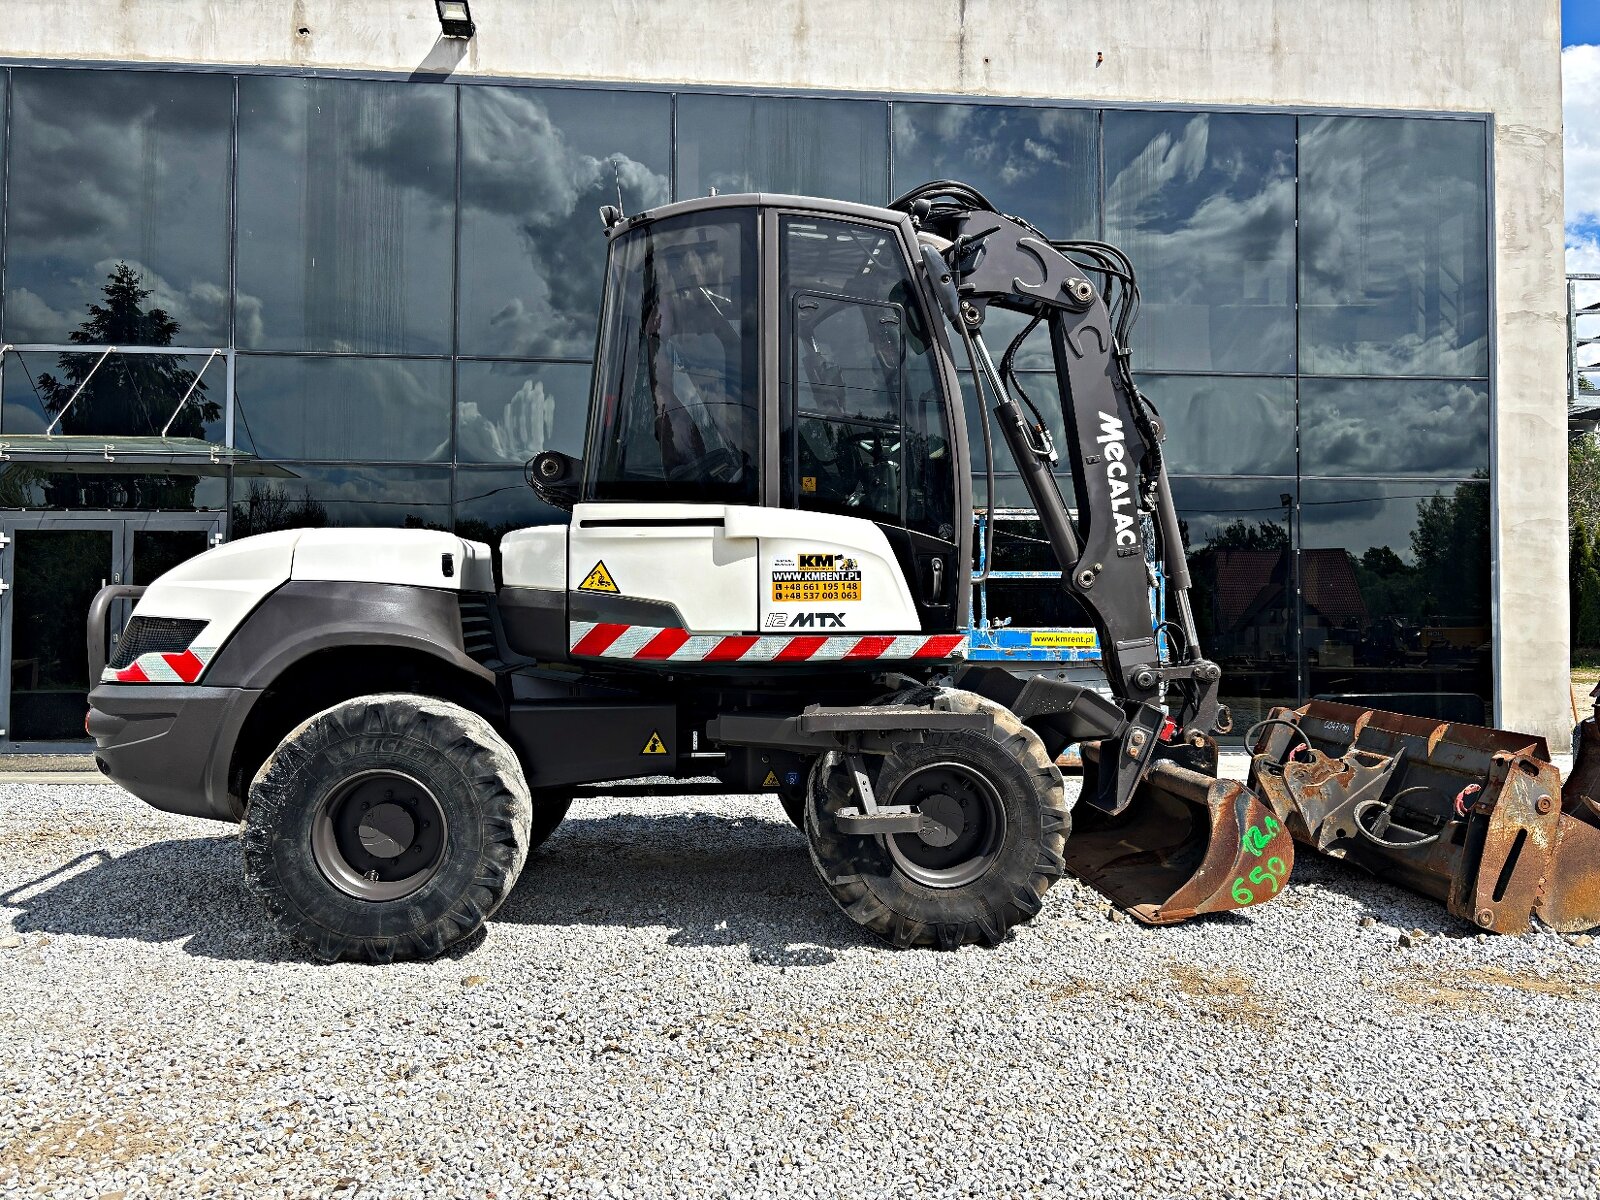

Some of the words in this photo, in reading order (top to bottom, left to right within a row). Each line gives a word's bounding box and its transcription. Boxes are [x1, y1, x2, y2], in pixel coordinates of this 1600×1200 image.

[799, 555, 834, 567] KM
[773, 571, 861, 581] WWW.KMRENT.PL
[784, 583, 801, 591] +48
[803, 583, 819, 591] 661
[823, 583, 839, 591] 195
[841, 583, 858, 591] 148
[784, 592, 801, 600] +48
[803, 592, 819, 600] 537
[822, 592, 839, 600] 003
[841, 592, 858, 600] 063
[765, 613, 788, 627] 12
[788, 613, 847, 627] MTX
[1033, 635, 1094, 645] www.kmrent.pl
[1231, 856, 1286, 905] 650
